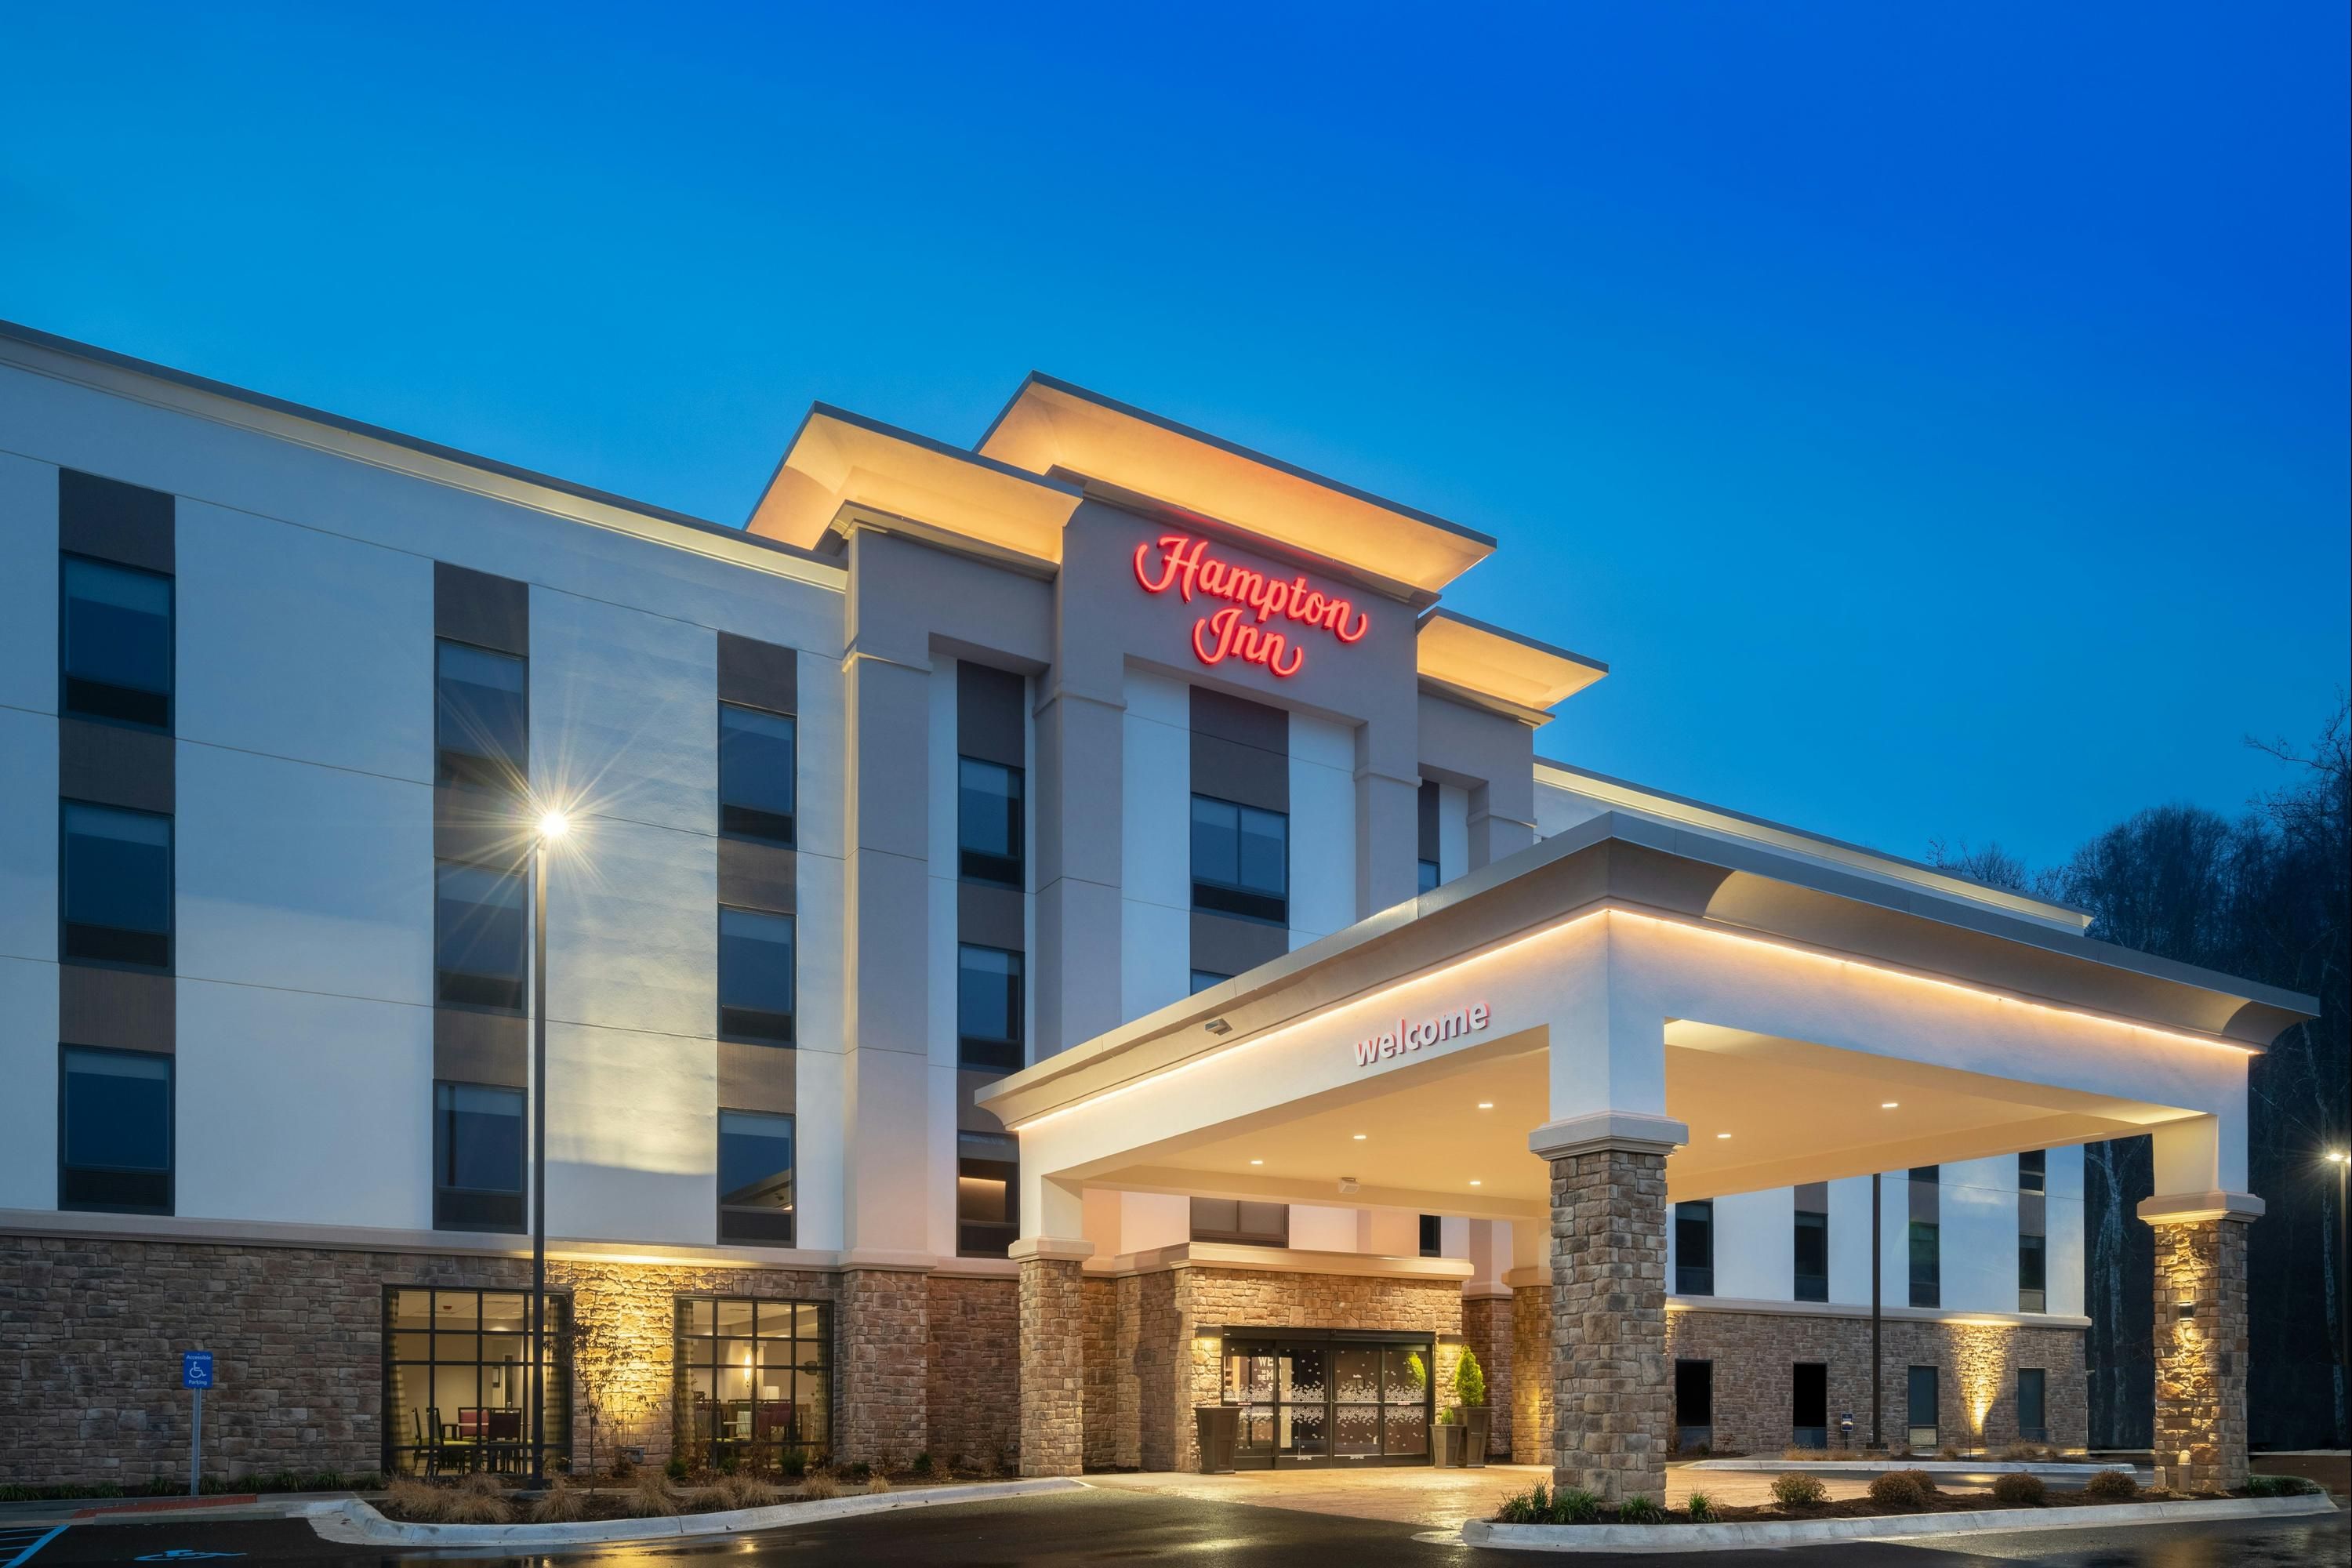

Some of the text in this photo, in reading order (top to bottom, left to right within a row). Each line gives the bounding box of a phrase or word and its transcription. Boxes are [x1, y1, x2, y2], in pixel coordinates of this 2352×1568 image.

[1134, 536, 1367, 643] Hampton
[1192, 608, 1302, 677] Inn
[1354, 1003, 1490, 1067] welcome
